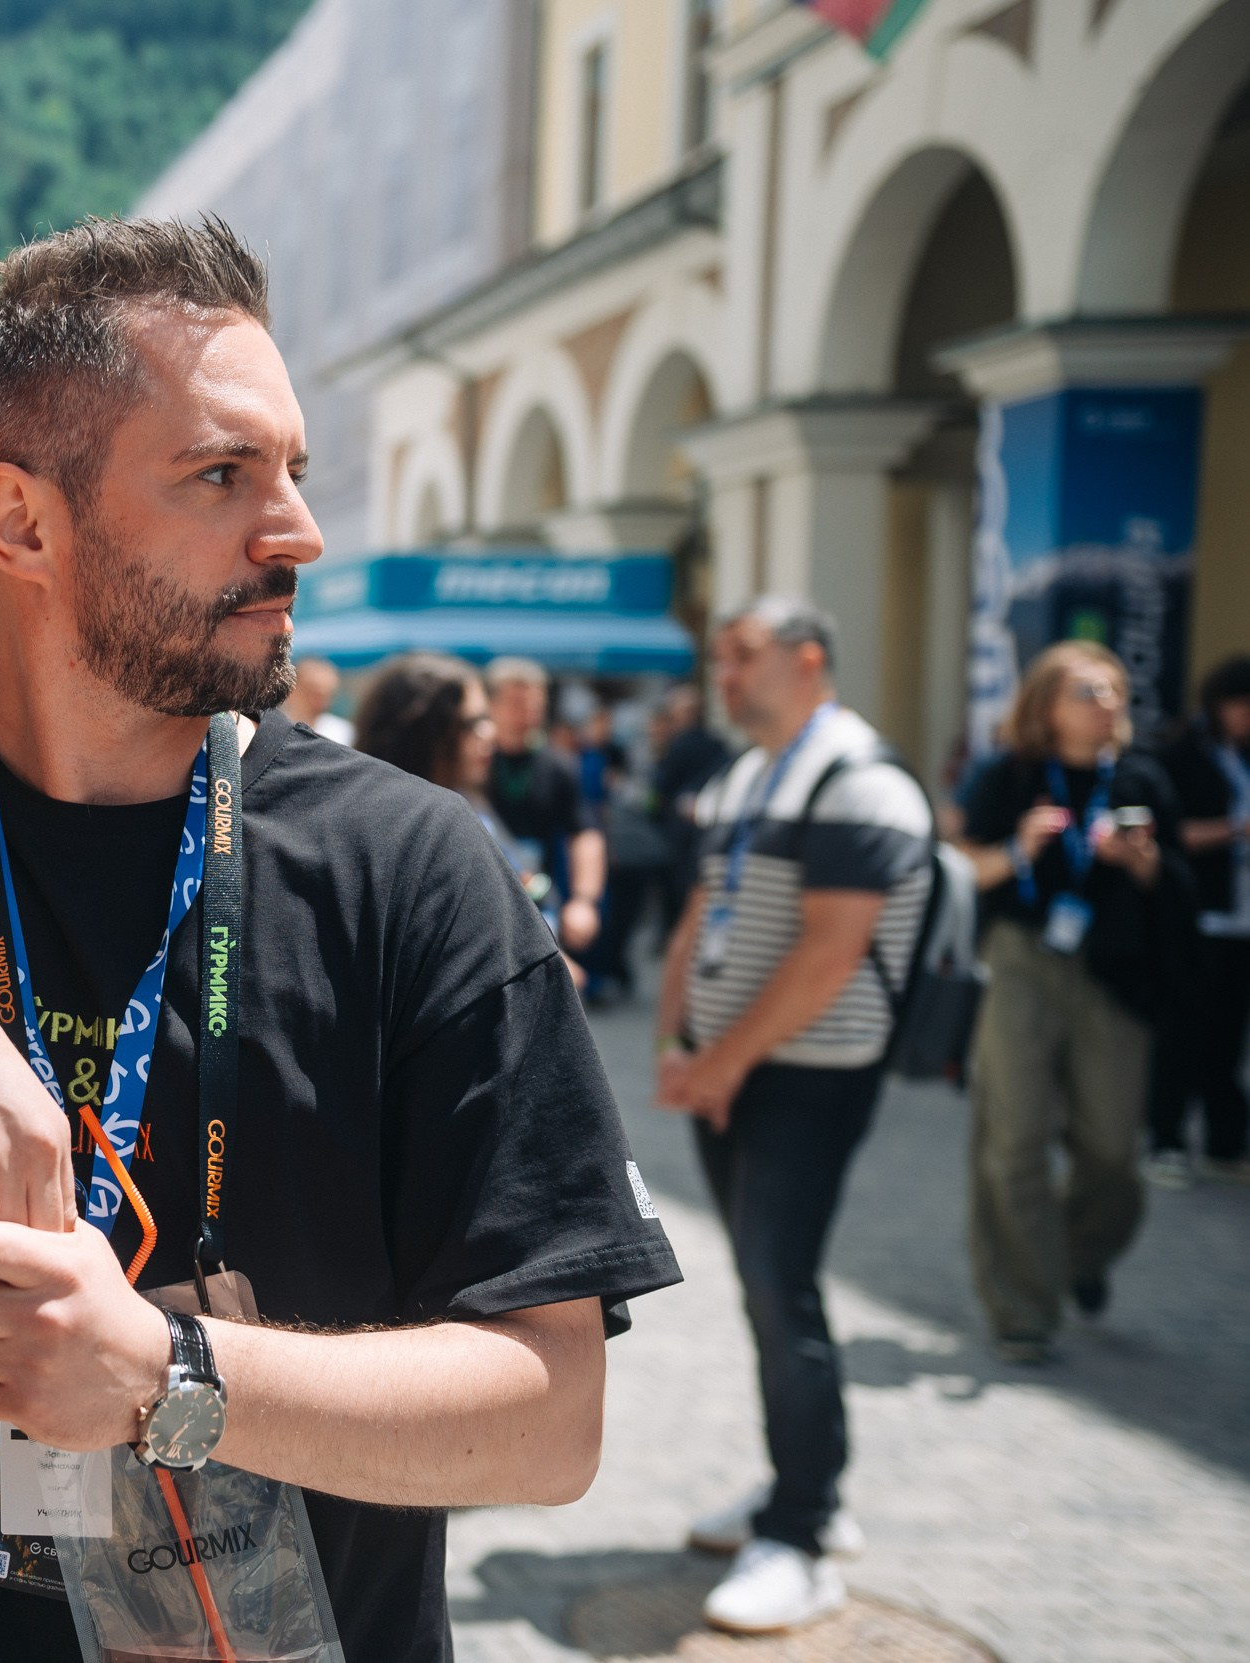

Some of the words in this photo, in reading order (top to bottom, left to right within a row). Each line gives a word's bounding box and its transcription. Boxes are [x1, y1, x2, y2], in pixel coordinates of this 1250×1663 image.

[213, 778, 232, 856] GOURMIX
[206, 1118, 226, 1220] GOURMIX
[127, 1522, 258, 1575] GOURMIX
